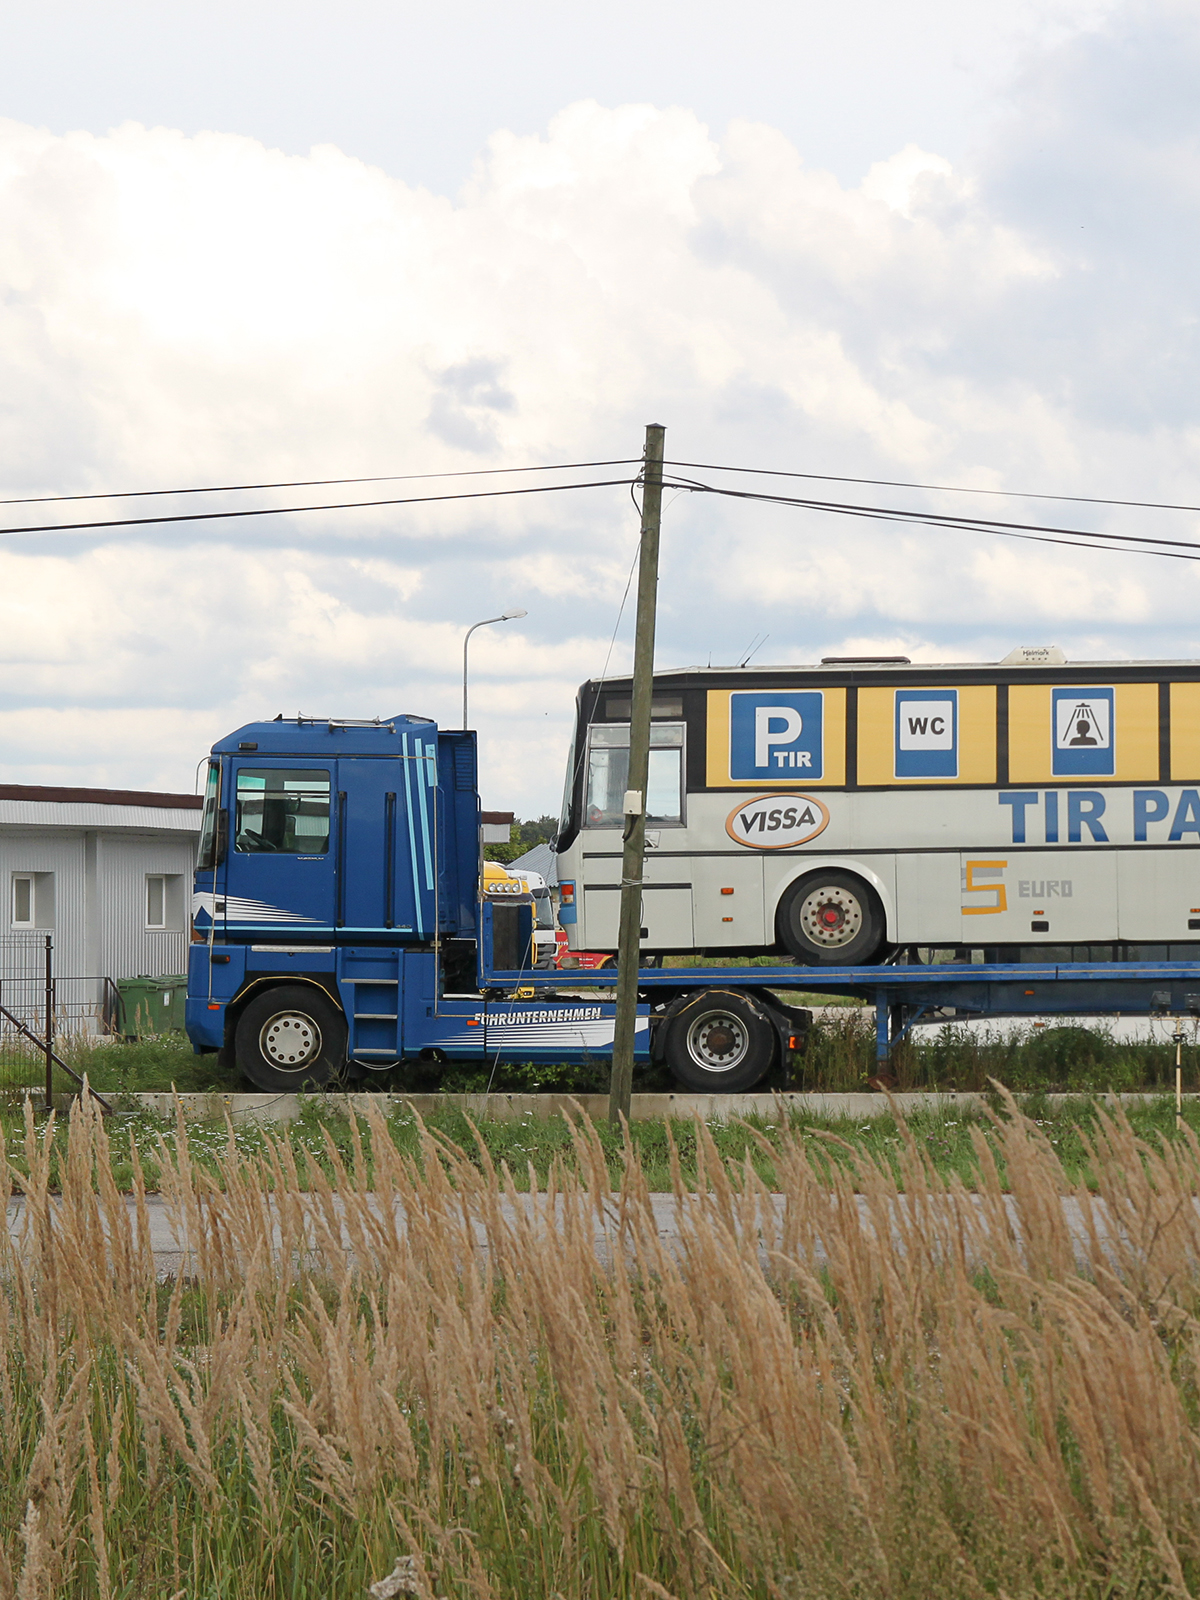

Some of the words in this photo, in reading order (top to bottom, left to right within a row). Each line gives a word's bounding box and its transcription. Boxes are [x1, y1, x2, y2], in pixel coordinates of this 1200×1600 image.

[755, 706, 803, 767] P
[908, 716, 945, 735] WC
[773, 751, 812, 768] TIR
[740, 806, 816, 834] VISSA
[998, 791, 1110, 843] TIR
[961, 860, 1008, 915] 5
[1018, 880, 1073, 898] EURO
